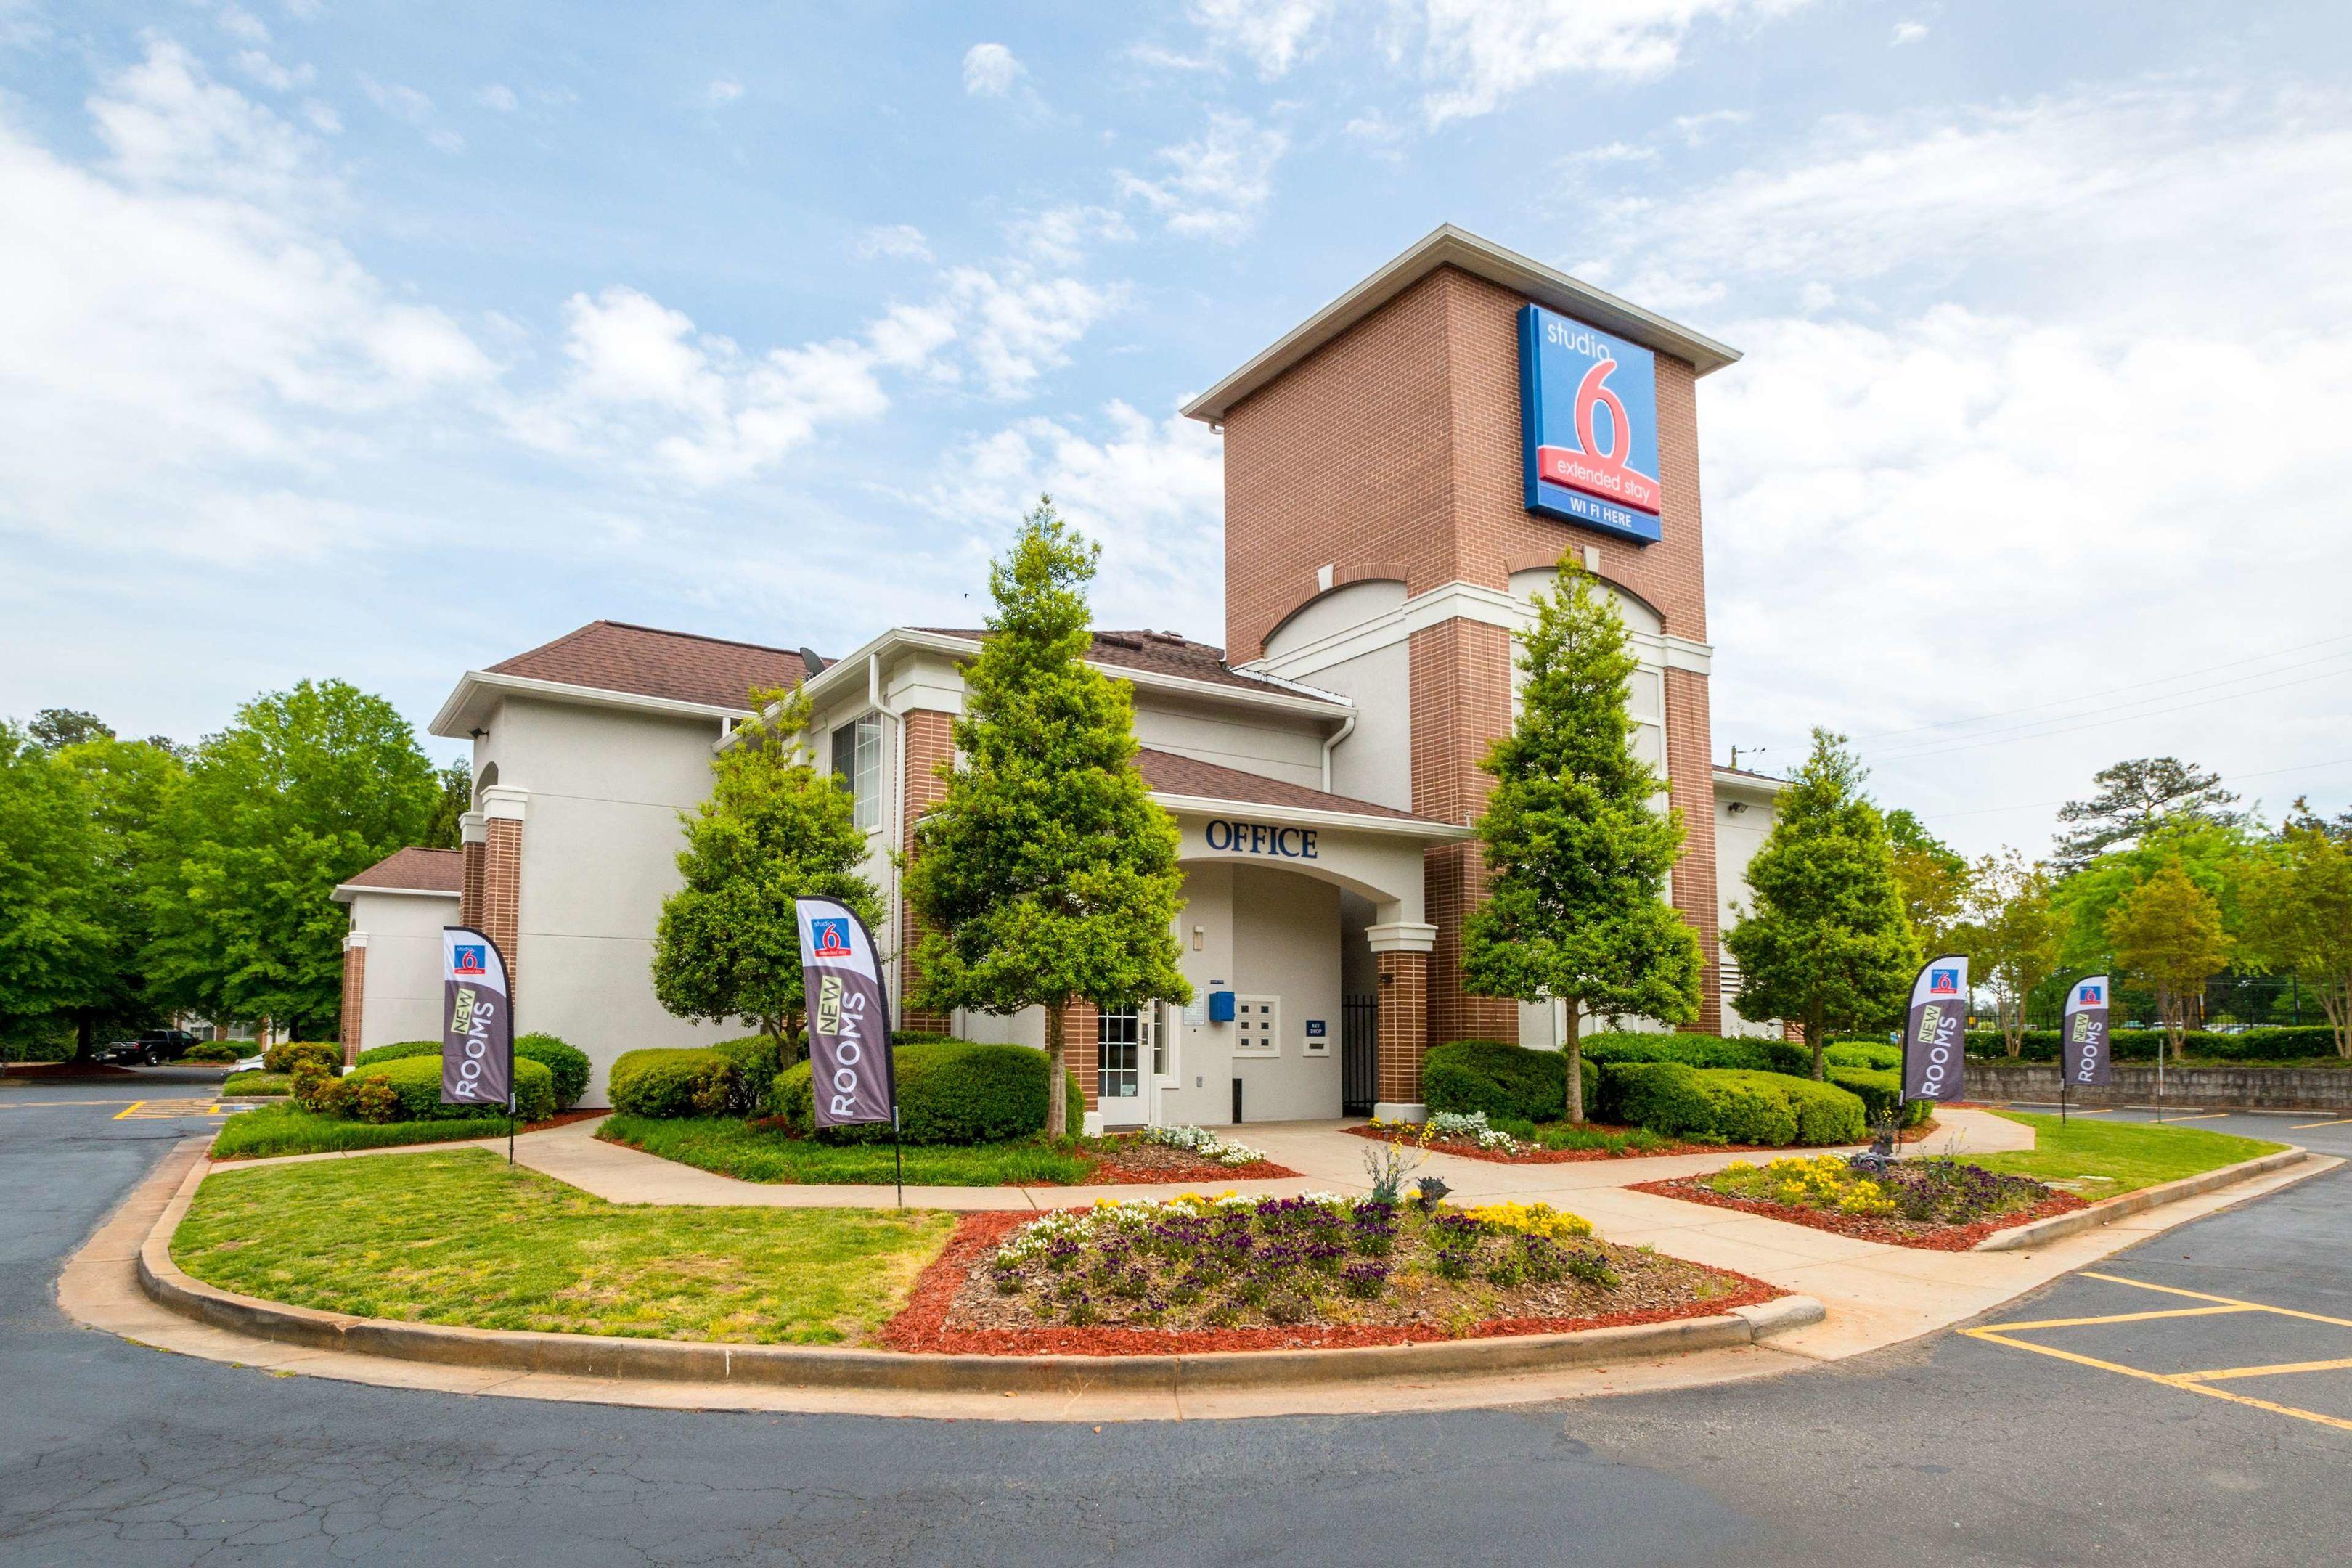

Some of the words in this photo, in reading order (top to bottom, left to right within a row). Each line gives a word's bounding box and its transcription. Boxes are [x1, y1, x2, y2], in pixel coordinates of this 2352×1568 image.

[1547, 322, 1610, 360] studio
[1574, 359, 1631, 463] 6
[1556, 459, 1621, 491] extended
[1625, 481, 1651, 505] stay
[1569, 497, 1587, 515] WI
[1590, 503, 1601, 520] FI
[1603, 507, 1633, 528] HERE
[1206, 819, 1318, 859] OFFICE
[822, 923, 841, 950] 6
[462, 949, 478, 970] 6
[1938, 973, 1951, 989] 6
[454, 989, 473, 1033] NEW
[820, 978, 841, 1036] NEW
[1920, 1007, 1939, 1042] NEW
[2074, 1014, 2088, 1042] NEW
[454, 1001, 495, 1098] ROOMS
[830, 991, 866, 1116] ROOMS
[1921, 1016, 1957, 1097] ROOMS
[2078, 1021, 2103, 1082] ROOMS
